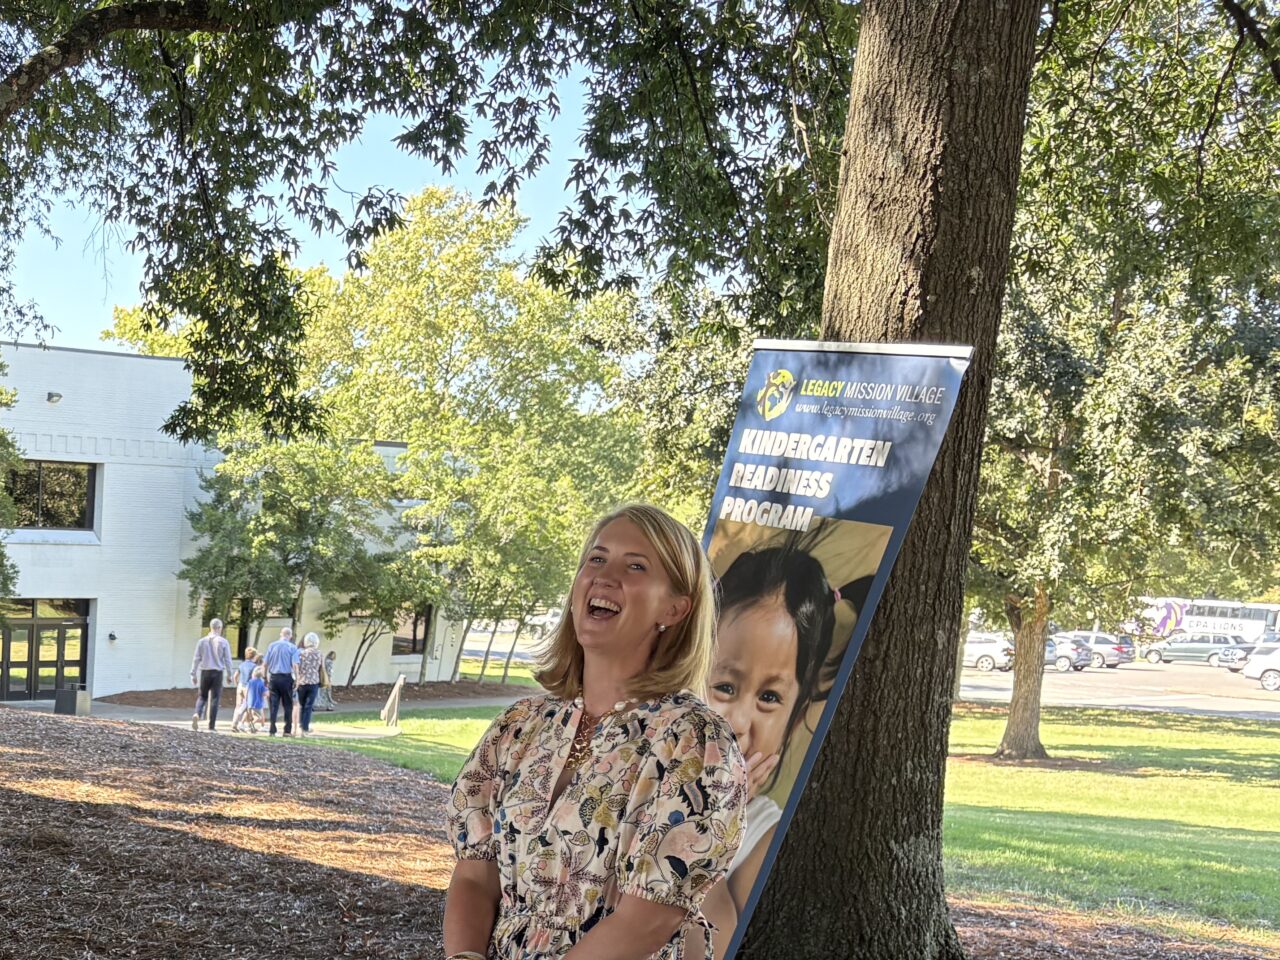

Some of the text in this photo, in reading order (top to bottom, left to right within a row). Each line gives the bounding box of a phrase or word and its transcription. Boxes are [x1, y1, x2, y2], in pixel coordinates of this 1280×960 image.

[800, 379, 946, 405] LEGACY MISSION VILLAGE
[738, 428, 893, 468] KINDERGARTEN
[729, 463, 834, 499] READINESS
[719, 496, 814, 532] PROGRAM
